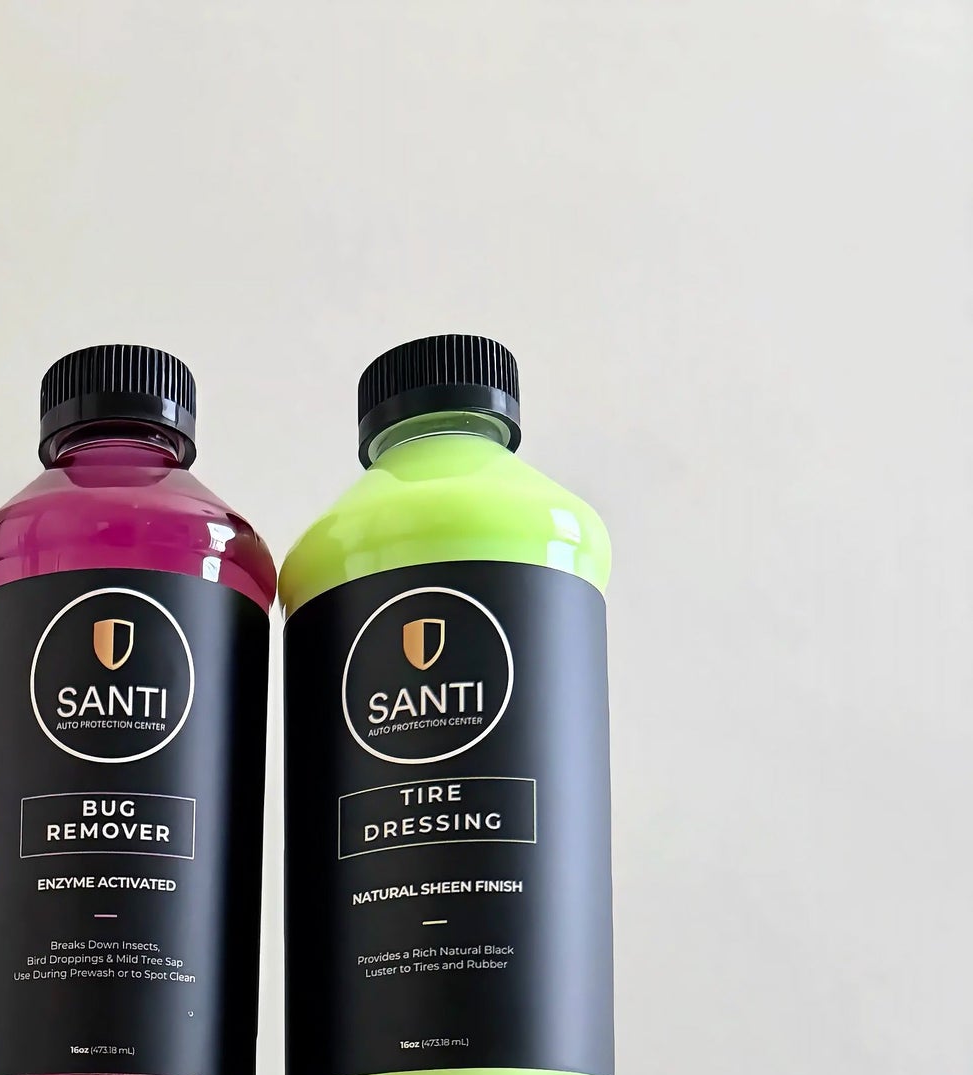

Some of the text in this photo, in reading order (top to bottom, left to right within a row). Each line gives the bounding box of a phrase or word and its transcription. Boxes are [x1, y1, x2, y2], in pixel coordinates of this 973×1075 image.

[57, 686, 166, 718] SANTI
[368, 681, 483, 725] SANTI
[56, 722, 78, 730] AUTO
[135, 722, 165, 731] CENTER
[368, 717, 483, 737] AUTO PROTECTION CENTER
[400, 784, 462, 805] TIRE
[83, 800, 134, 816] BUG
[47, 823, 169, 842] REMOVER
[364, 812, 501, 842] DRESSING
[38, 877, 176, 891] ENZYME ACTIVATED
[353, 881, 522, 905] NATURAL SHEEN FINISH
[51, 940, 160, 952] Breaks Down Insects,
[27, 954, 184, 968] Bird Droppings & Mild Tree Sap
[358, 952, 400, 965] Provides
[413, 948, 436, 958] Rich
[440, 945, 481, 955] Natural
[485, 946, 514, 954] Black
[14, 972, 30, 980] Use
[33, 969, 67, 979] During
[71, 968, 114, 977] Prewash
[132, 970, 142, 978] to
[145, 970, 167, 980] Spot
[170, 972, 195, 983] Clean
[366, 967, 397, 977] Luster
[413, 962, 439, 971] Tires
[442, 960, 463, 969] and
[467, 960, 507, 968] Rubber
[452, 1038, 469, 1046] mL)
[119, 1047, 135, 1055] mL)
